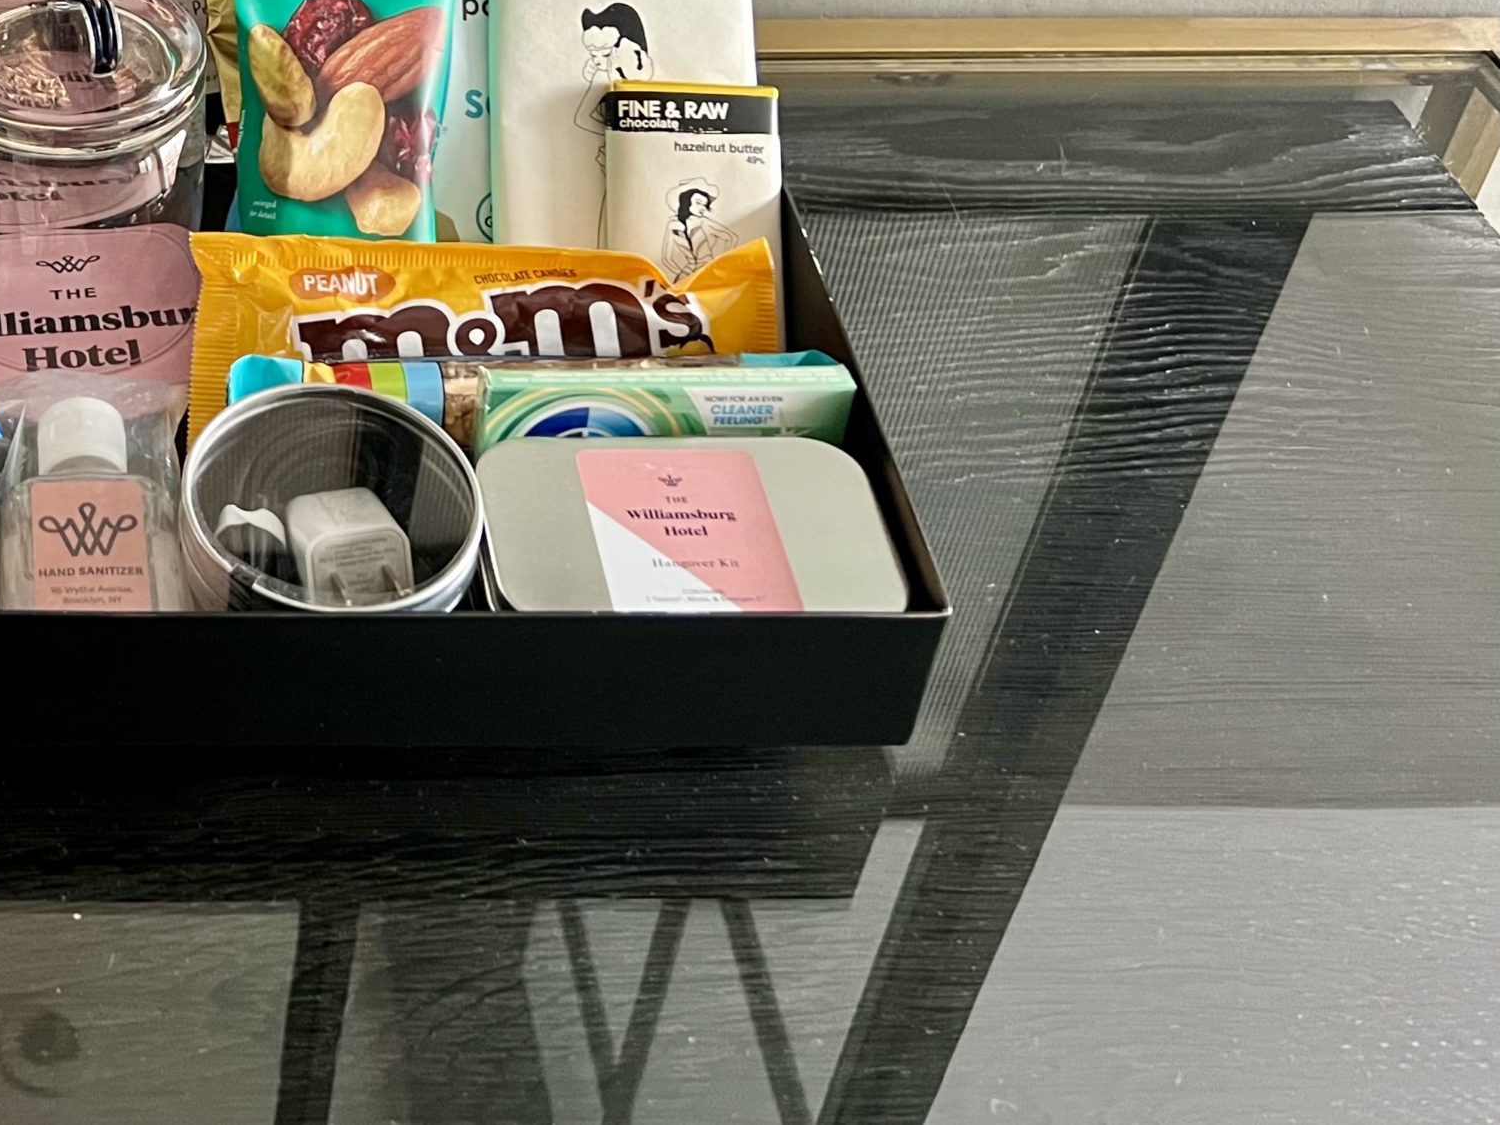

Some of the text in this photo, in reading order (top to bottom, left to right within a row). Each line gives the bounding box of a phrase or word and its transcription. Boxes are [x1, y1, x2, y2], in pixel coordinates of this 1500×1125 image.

[617, 100, 729, 120] FINE & RAW
[619, 118, 679, 130] chocolate
[674, 141, 765, 154] hazelnut butter
[473, 267, 577, 285] CHOCOLATE CANDIES
[303, 271, 378, 295] PEANUT
[50, 287, 97, 301] THE
[22, 339, 142, 373] Hotel
[710, 404, 774, 416] CLEANER
[666, 496, 688, 504] THE
[626, 508, 737, 522] Williamsburg
[664, 525, 708, 537] Hotel
[652, 558, 714, 569] Hangover
[39, 565, 143, 578] HAND SANITIZER
